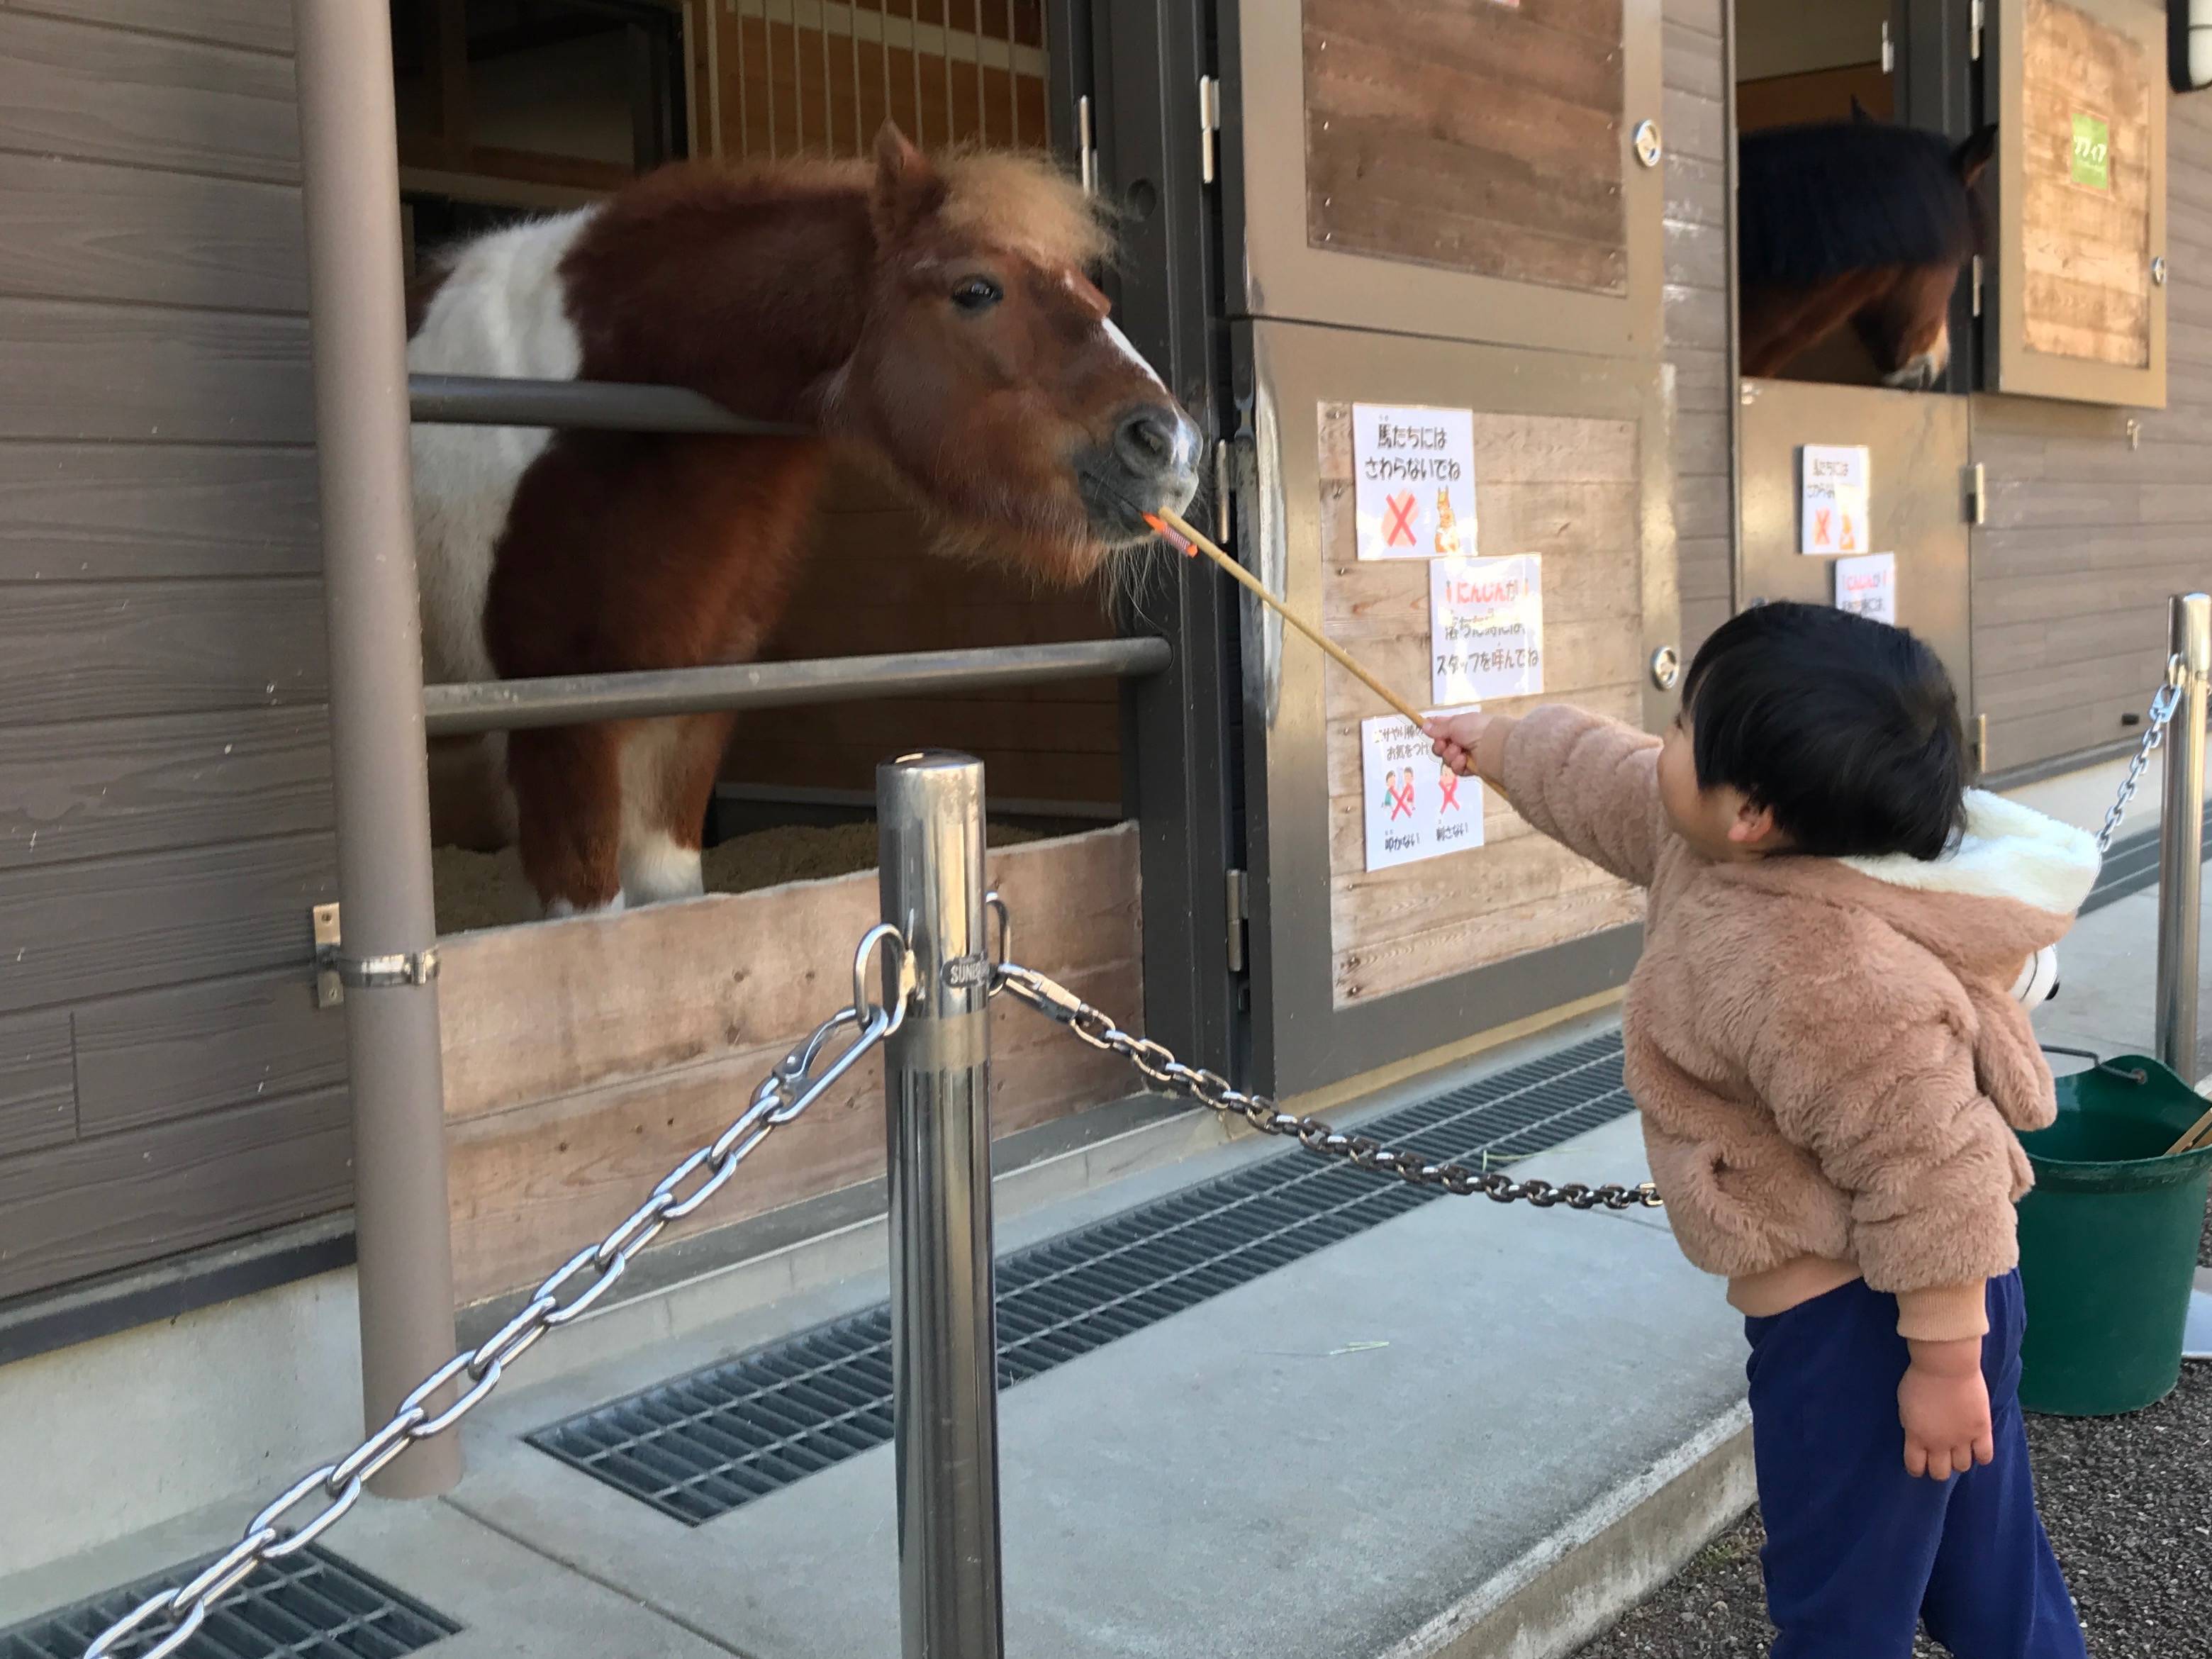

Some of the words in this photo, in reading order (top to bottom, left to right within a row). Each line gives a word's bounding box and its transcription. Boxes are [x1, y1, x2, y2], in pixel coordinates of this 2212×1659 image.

[1378, 423, 1447, 450] 馬たちには
[1365, 456, 1461, 481] さわらないでね
[1436, 648, 1539, 676] スタッフを呼んでね
